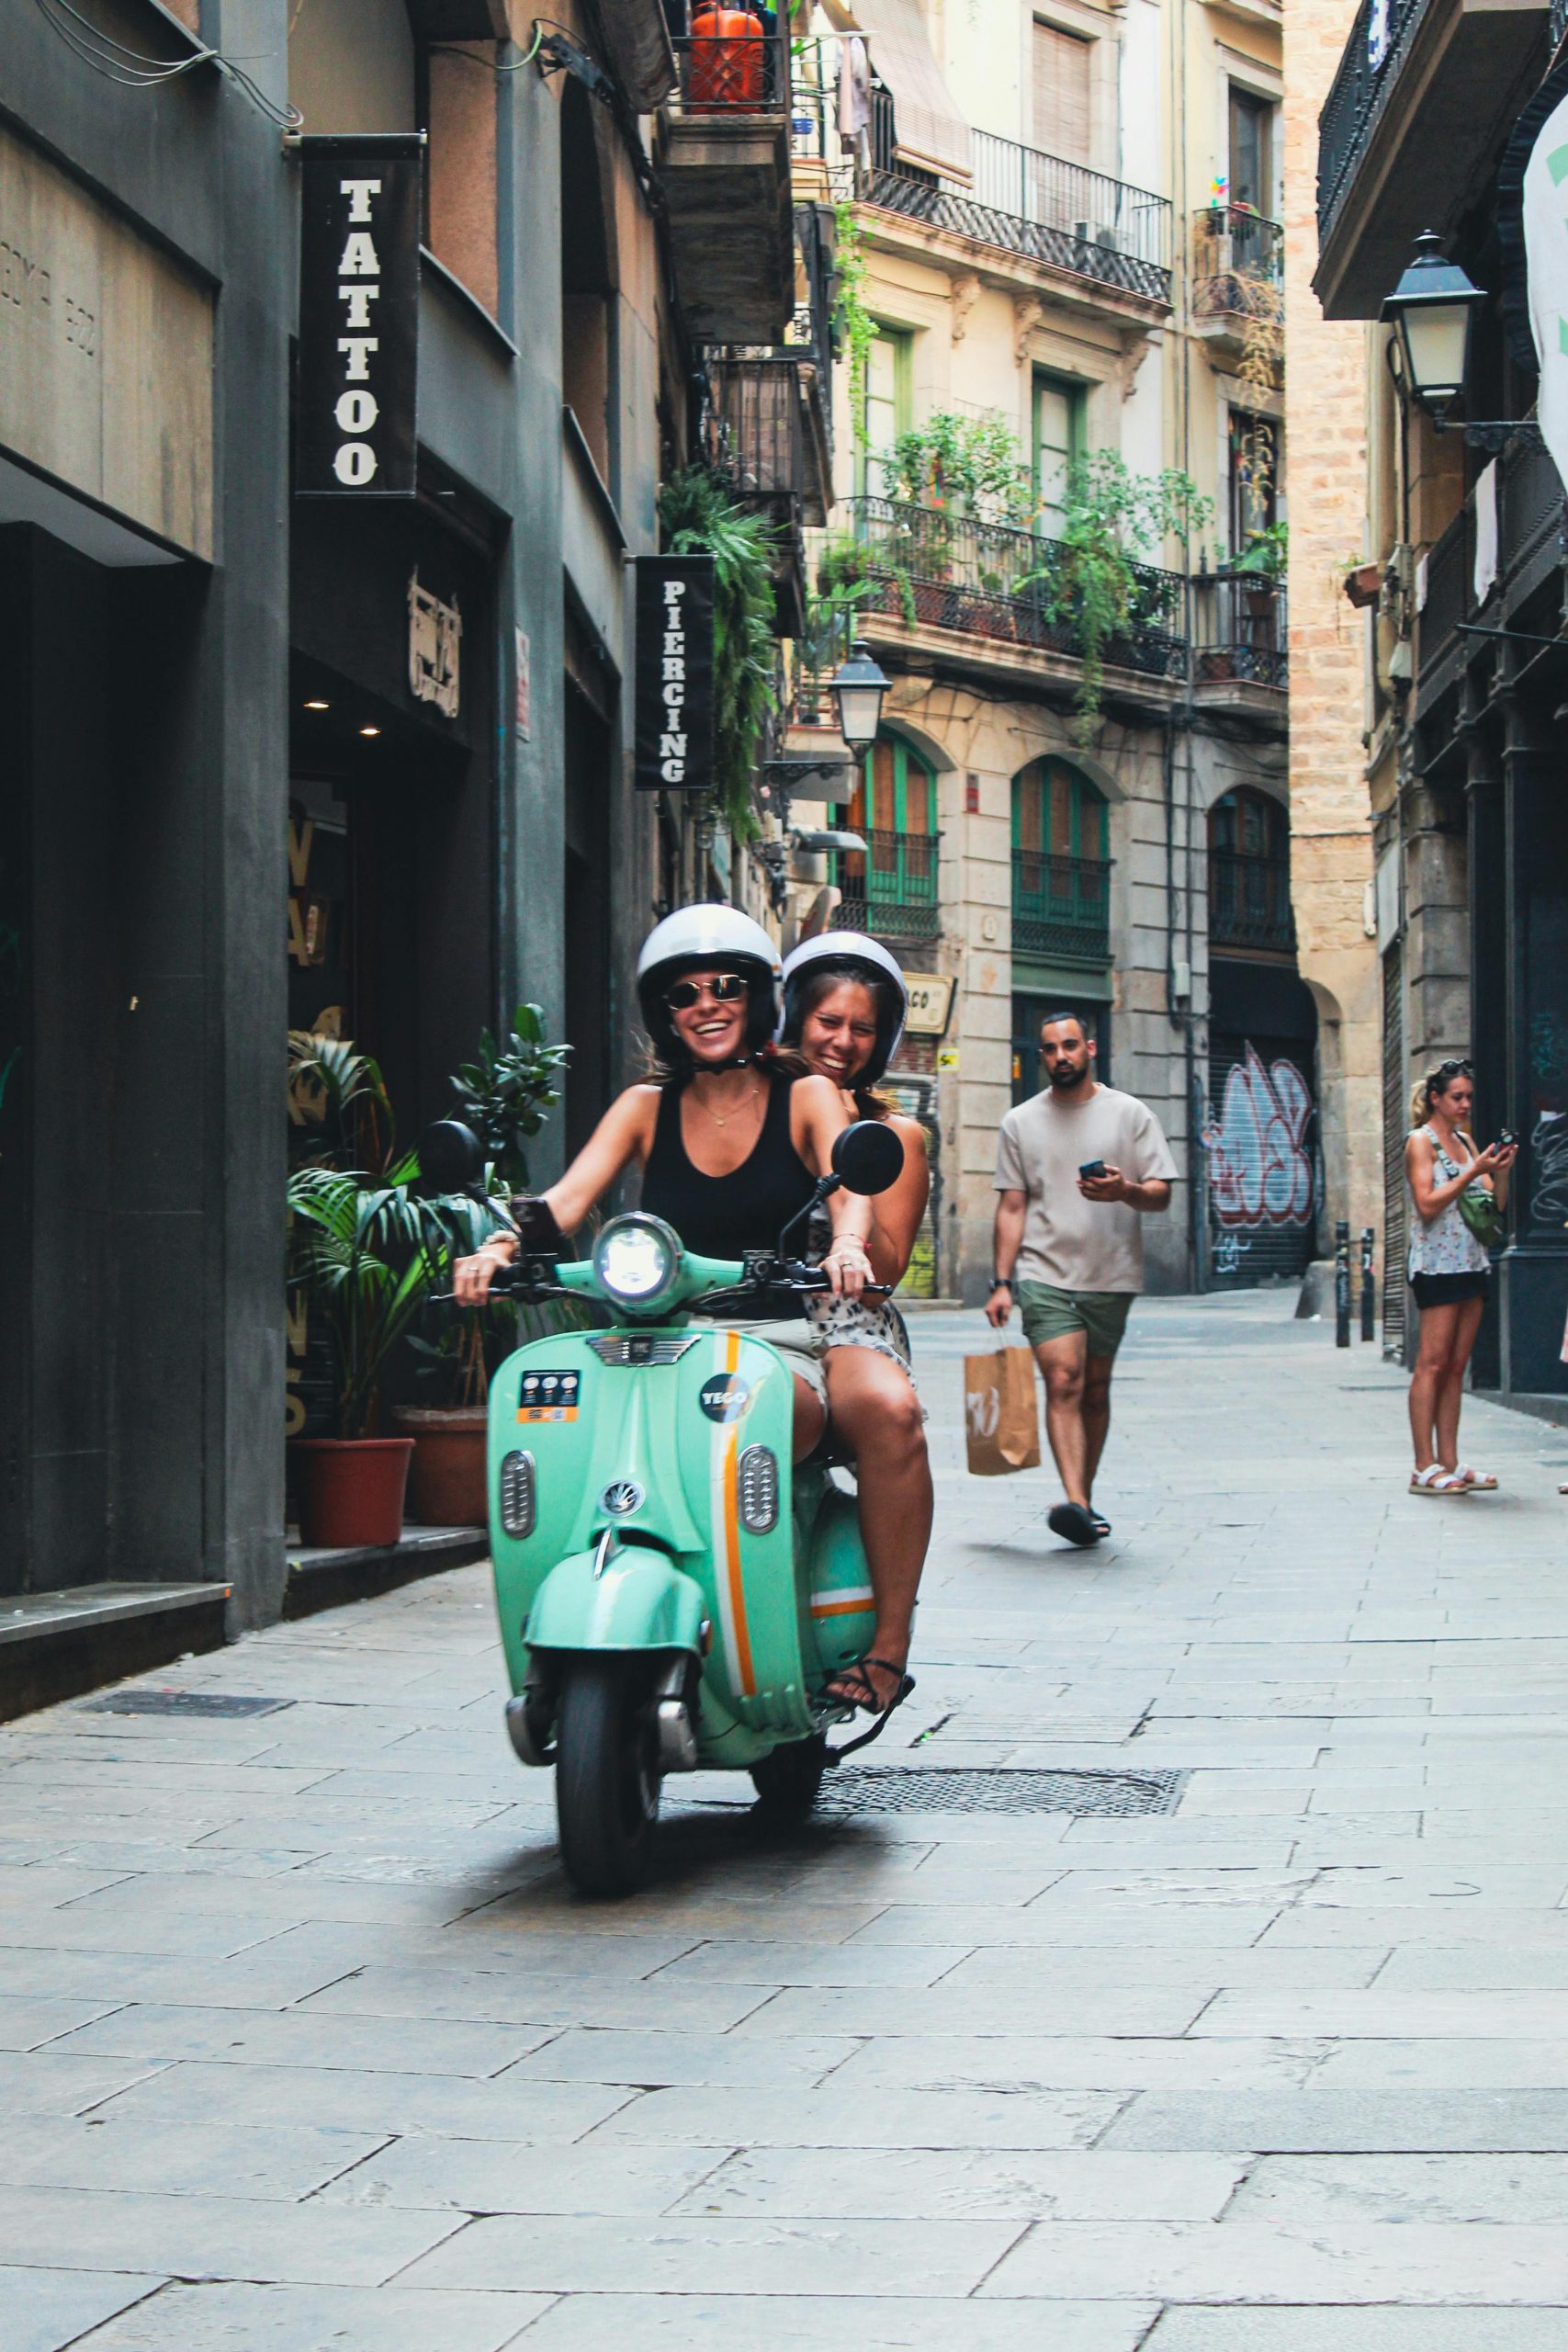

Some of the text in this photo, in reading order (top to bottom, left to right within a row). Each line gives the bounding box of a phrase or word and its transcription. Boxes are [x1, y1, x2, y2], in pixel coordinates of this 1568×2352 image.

[333, 179, 382, 486] TATTOO
[659, 581, 688, 783] PIERCING
[701, 1391, 748, 1405] YEGO
